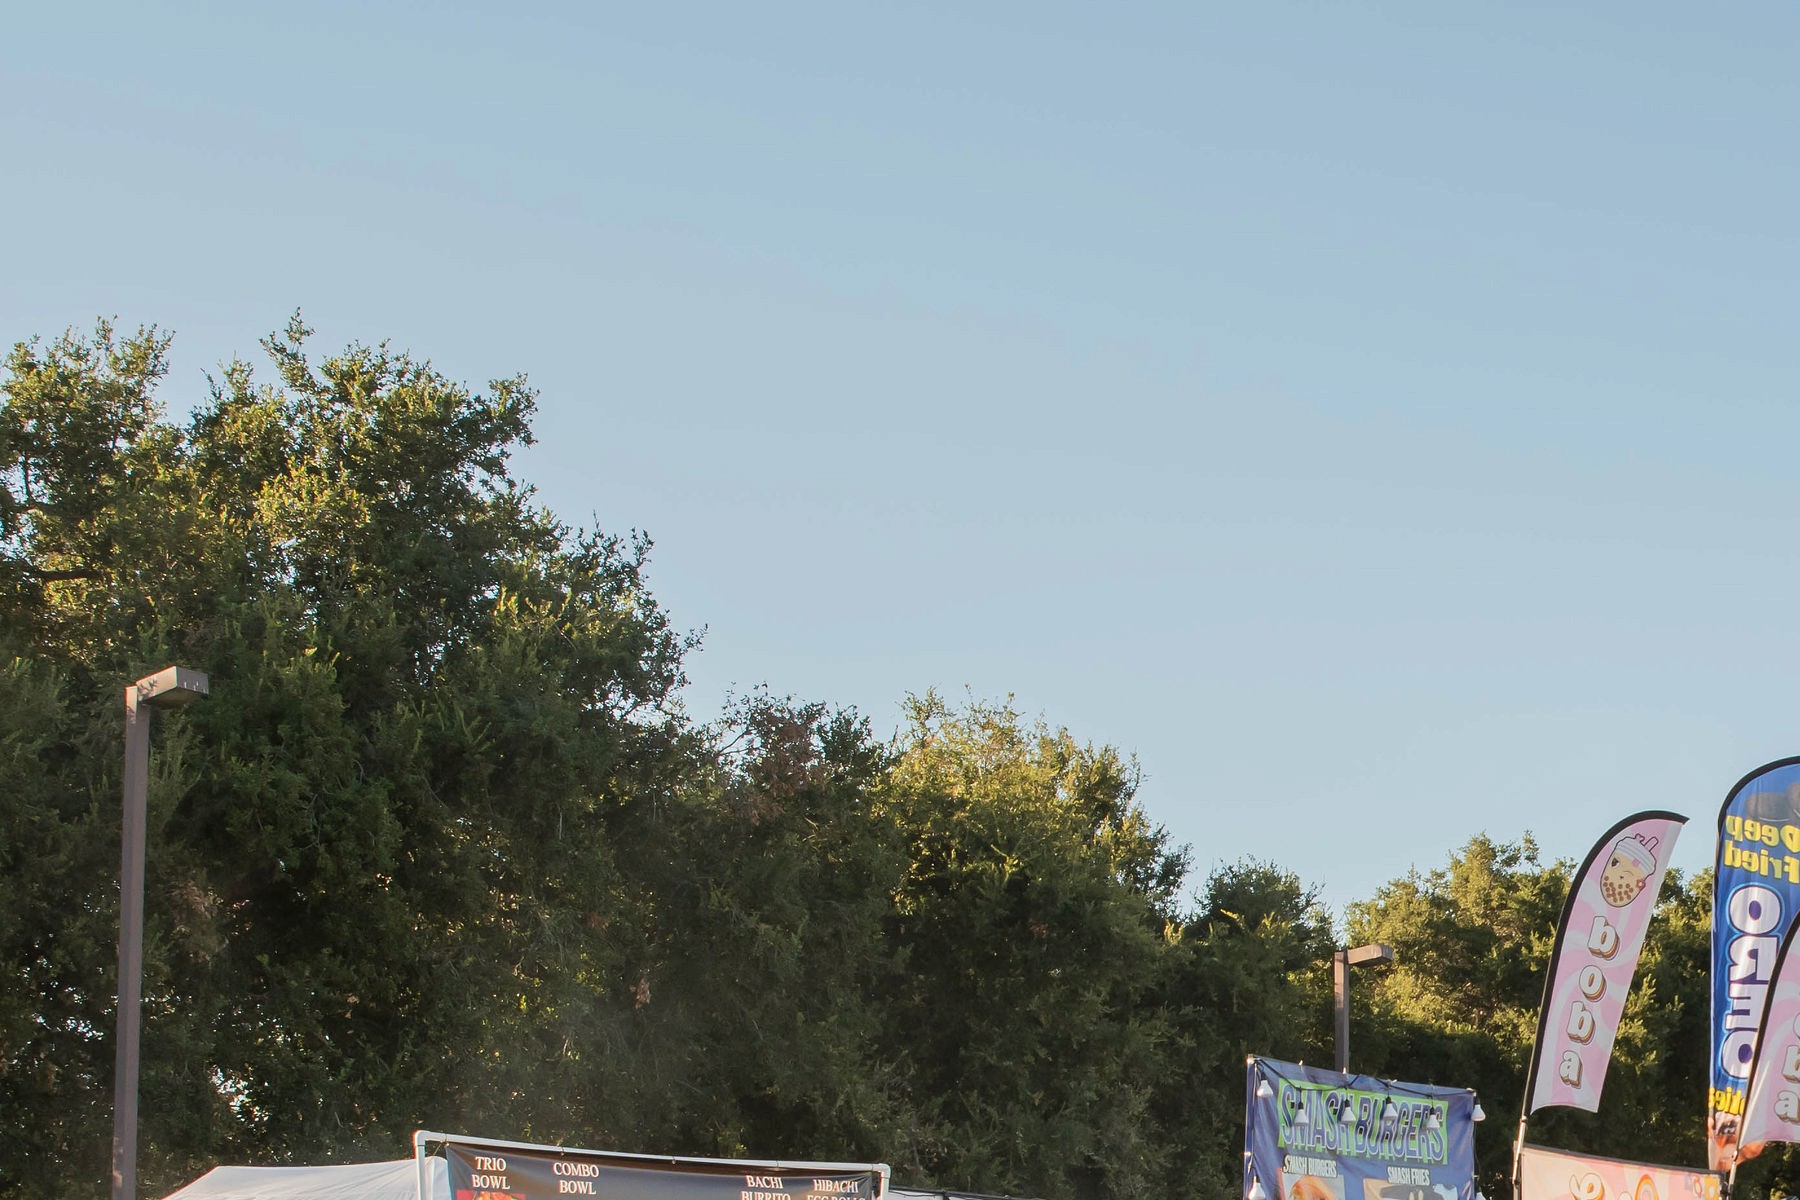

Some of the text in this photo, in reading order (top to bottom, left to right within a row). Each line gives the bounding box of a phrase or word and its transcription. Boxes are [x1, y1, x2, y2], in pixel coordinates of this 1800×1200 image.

[1559, 915, 1620, 1088] boba
[1282, 1084, 1444, 1161] SMASH BURGERS
[475, 1156, 507, 1172] TRIO
[553, 1162, 599, 1178] COMBO
[1283, 1155, 1337, 1178] SMASH BURGERS
[472, 1174, 511, 1190] BOWL
[746, 1175, 784, 1189] BACHI
[1387, 1166, 1430, 1186] SMASH FRIES
[560, 1180, 597, 1195] BOWL
[813, 1179, 859, 1193] HIBACHI
